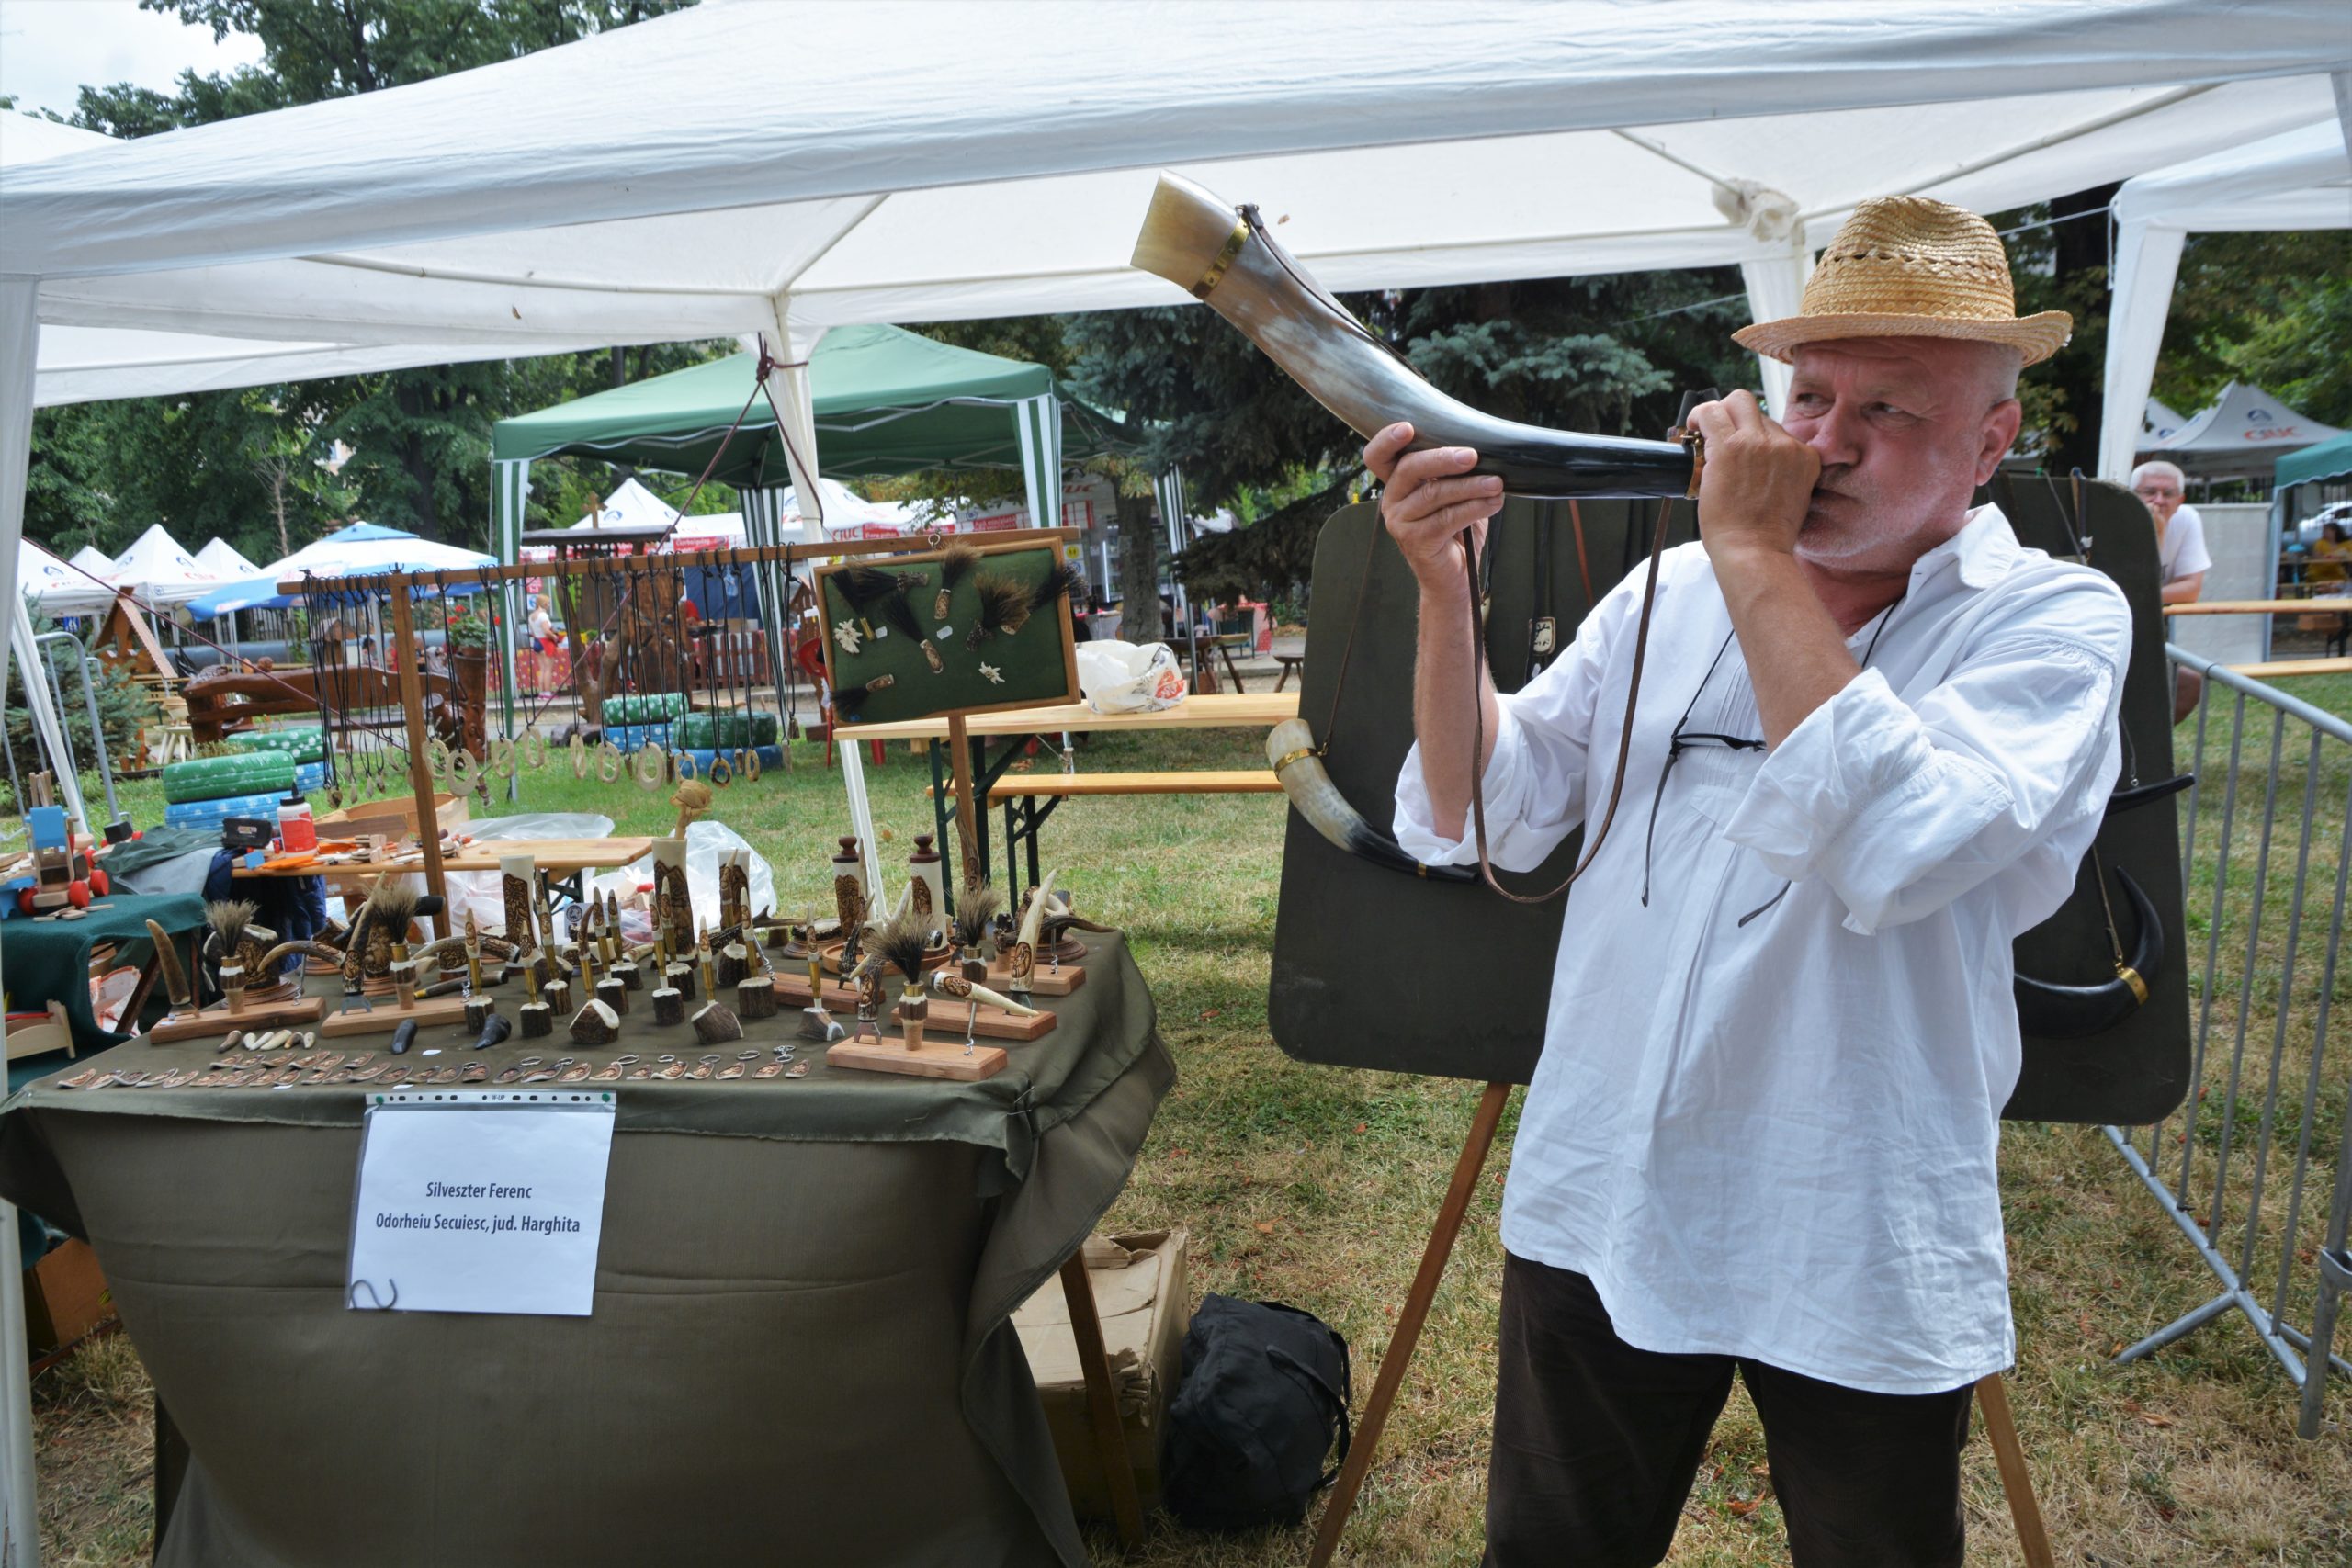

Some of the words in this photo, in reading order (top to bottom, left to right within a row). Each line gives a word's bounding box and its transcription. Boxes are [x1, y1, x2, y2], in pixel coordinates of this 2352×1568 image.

[425, 1181, 486, 1199] Silveszter
[489, 1182, 532, 1199] Ferenc
[376, 1213, 431, 1230] Odorheiu
[434, 1213, 490, 1233] Secuiesc,
[492, 1214, 517, 1234] jud.
[521, 1215, 581, 1235] Harghita
